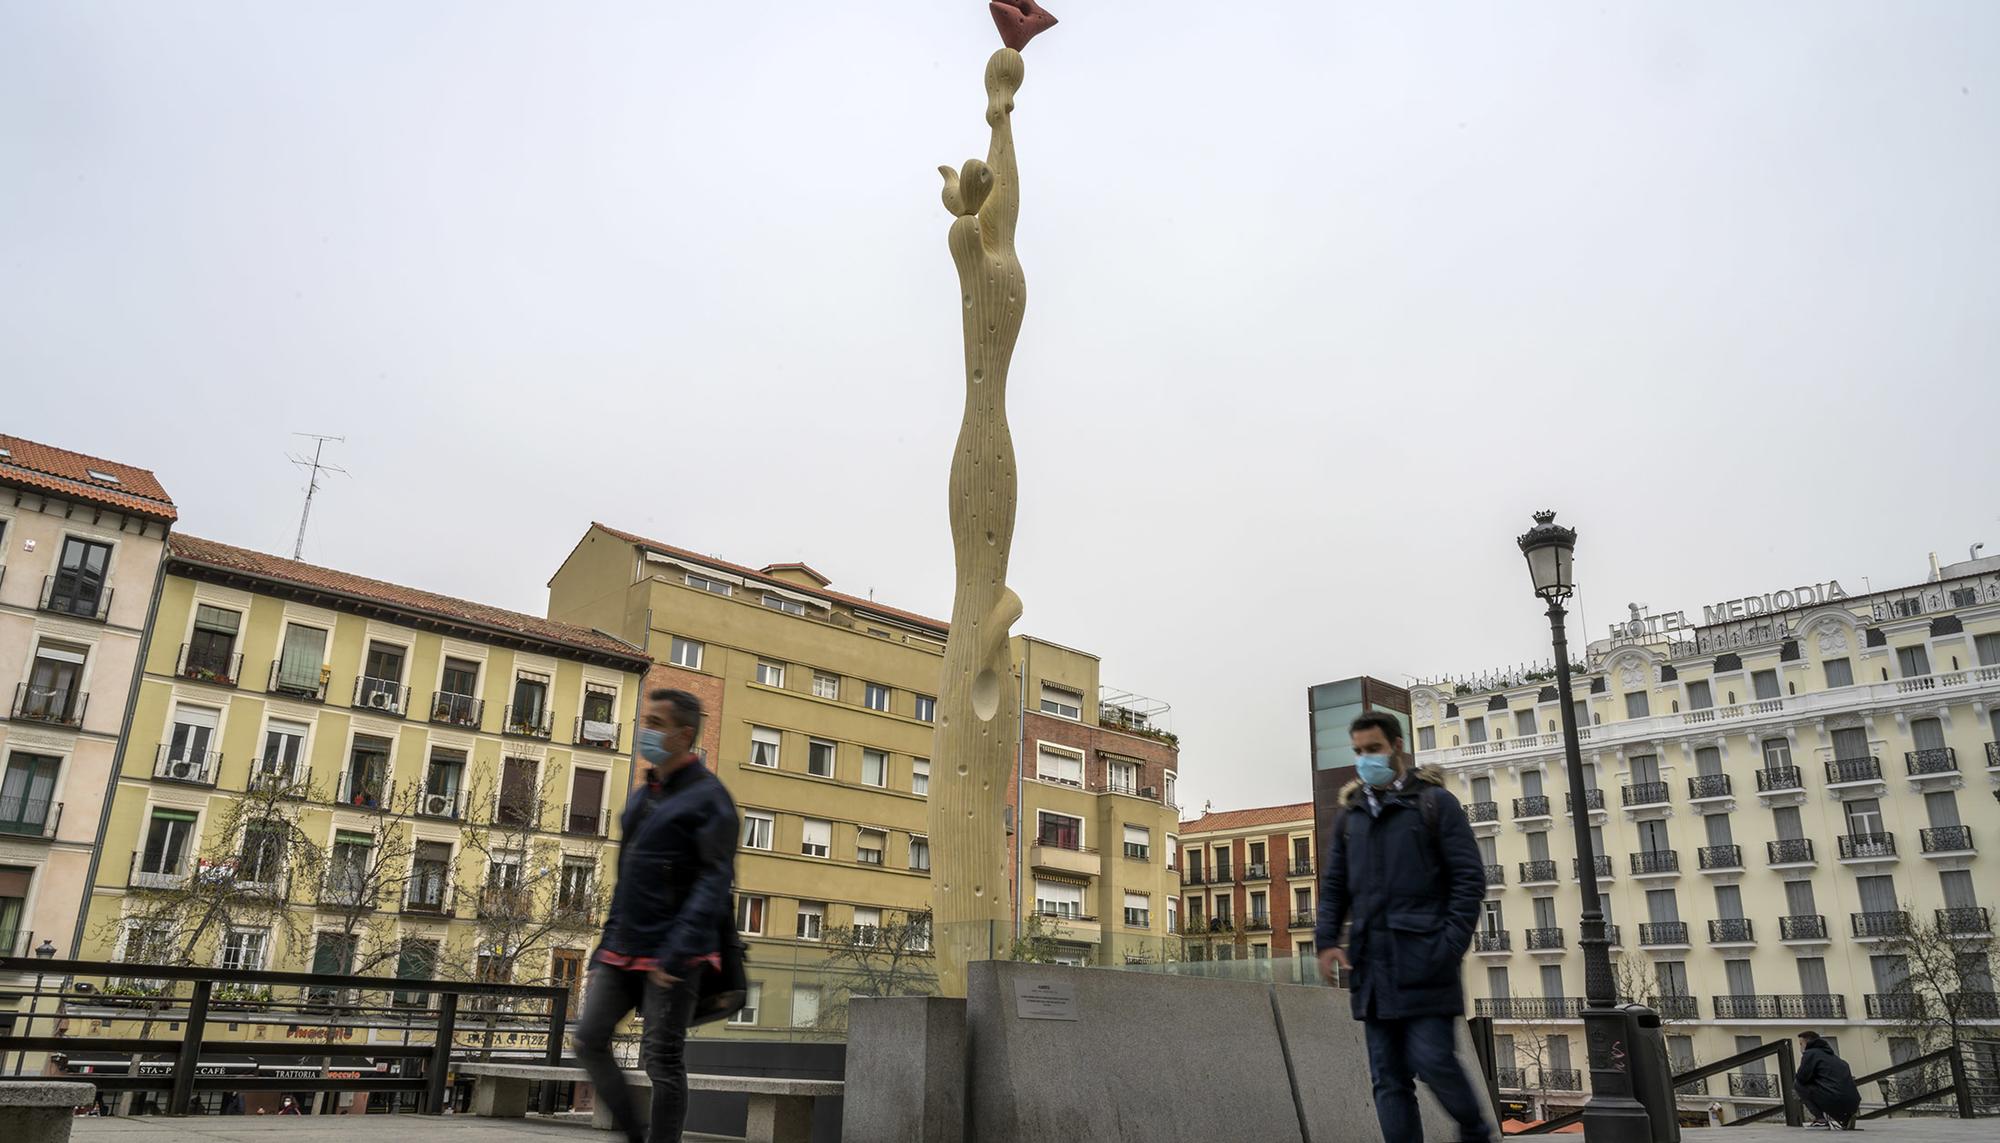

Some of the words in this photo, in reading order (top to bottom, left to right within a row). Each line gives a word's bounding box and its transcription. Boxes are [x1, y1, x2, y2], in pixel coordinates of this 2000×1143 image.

[1608, 610, 1695, 641] HOTEL
[1703, 579, 1848, 626] MEDIODIA
[275, 1070, 316, 1078] TRATTORIA
